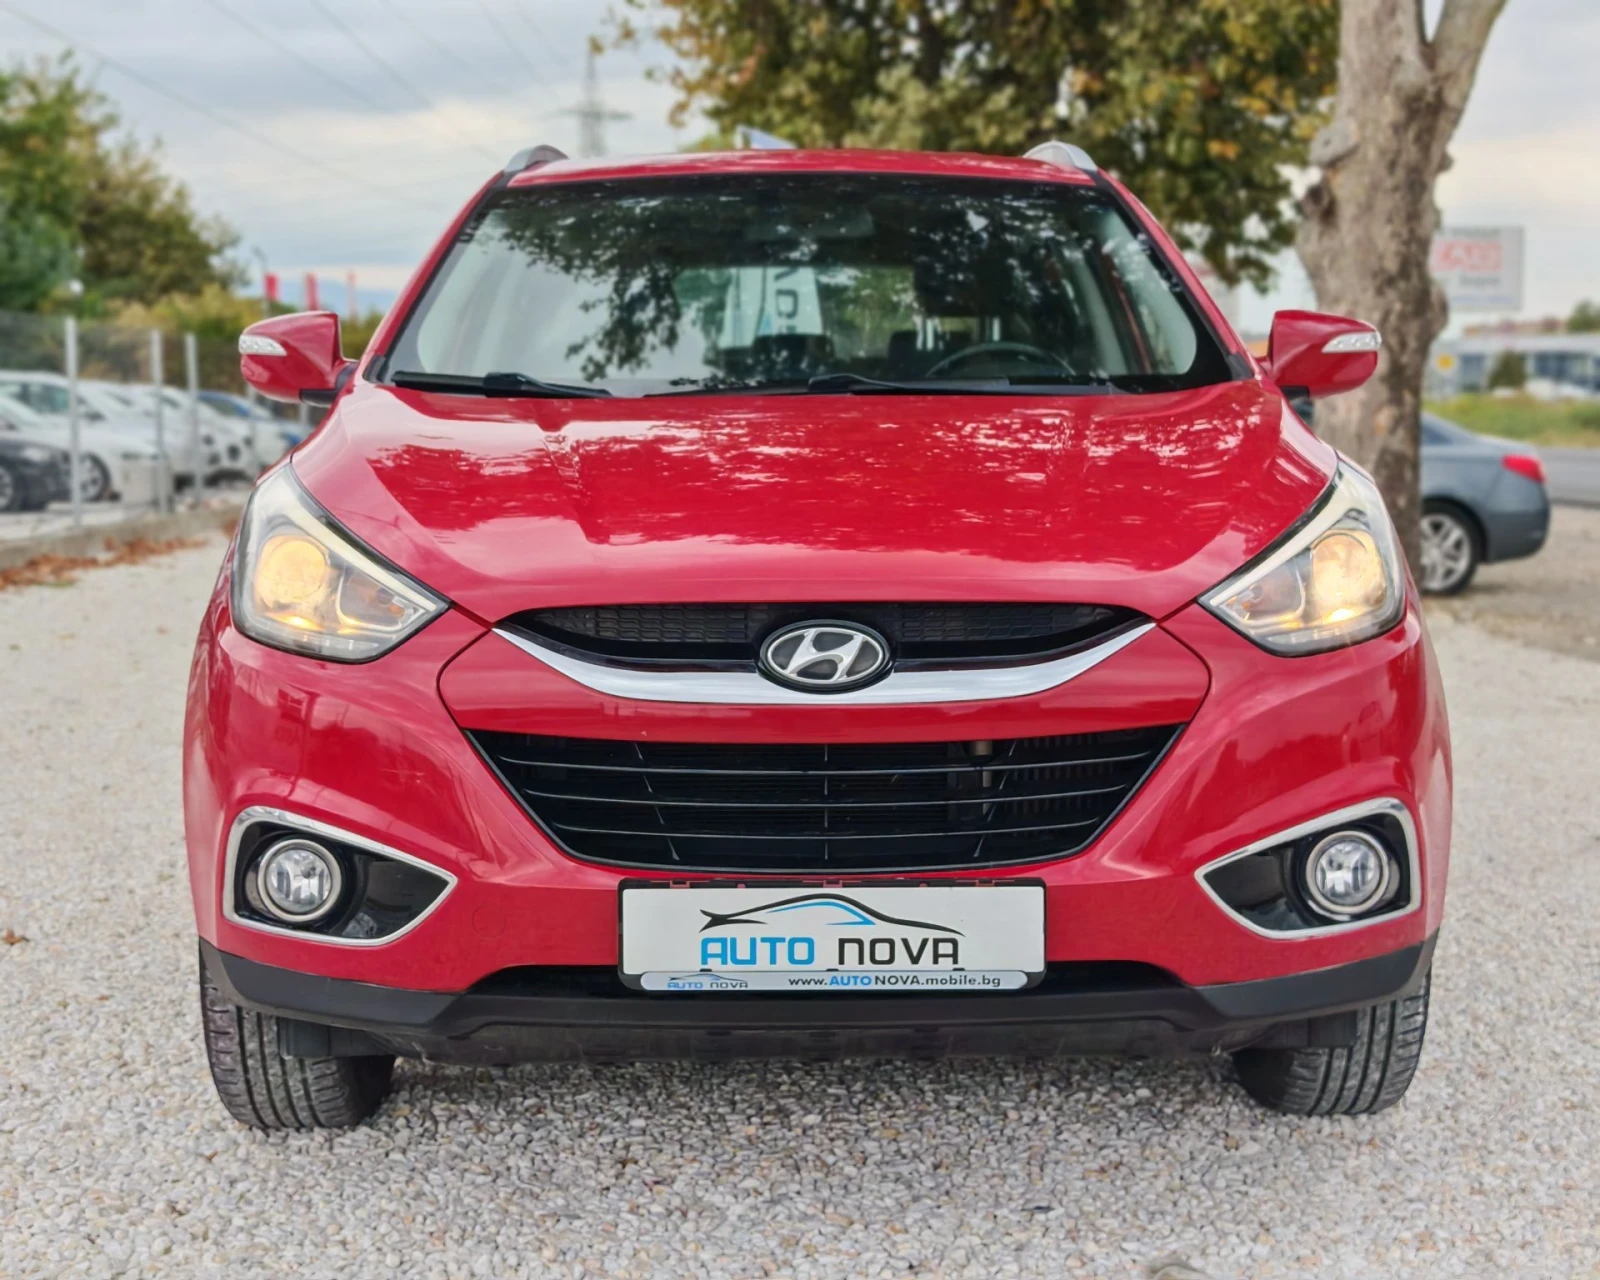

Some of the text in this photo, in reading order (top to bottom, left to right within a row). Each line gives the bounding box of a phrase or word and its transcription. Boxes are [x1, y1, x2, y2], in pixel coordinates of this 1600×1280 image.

[700, 937, 959, 966] AUTO NOVA
[667, 981, 749, 989] AUTO NOVA
[788, 974, 1001, 988] www.AUTONOVA.mobile.bg
